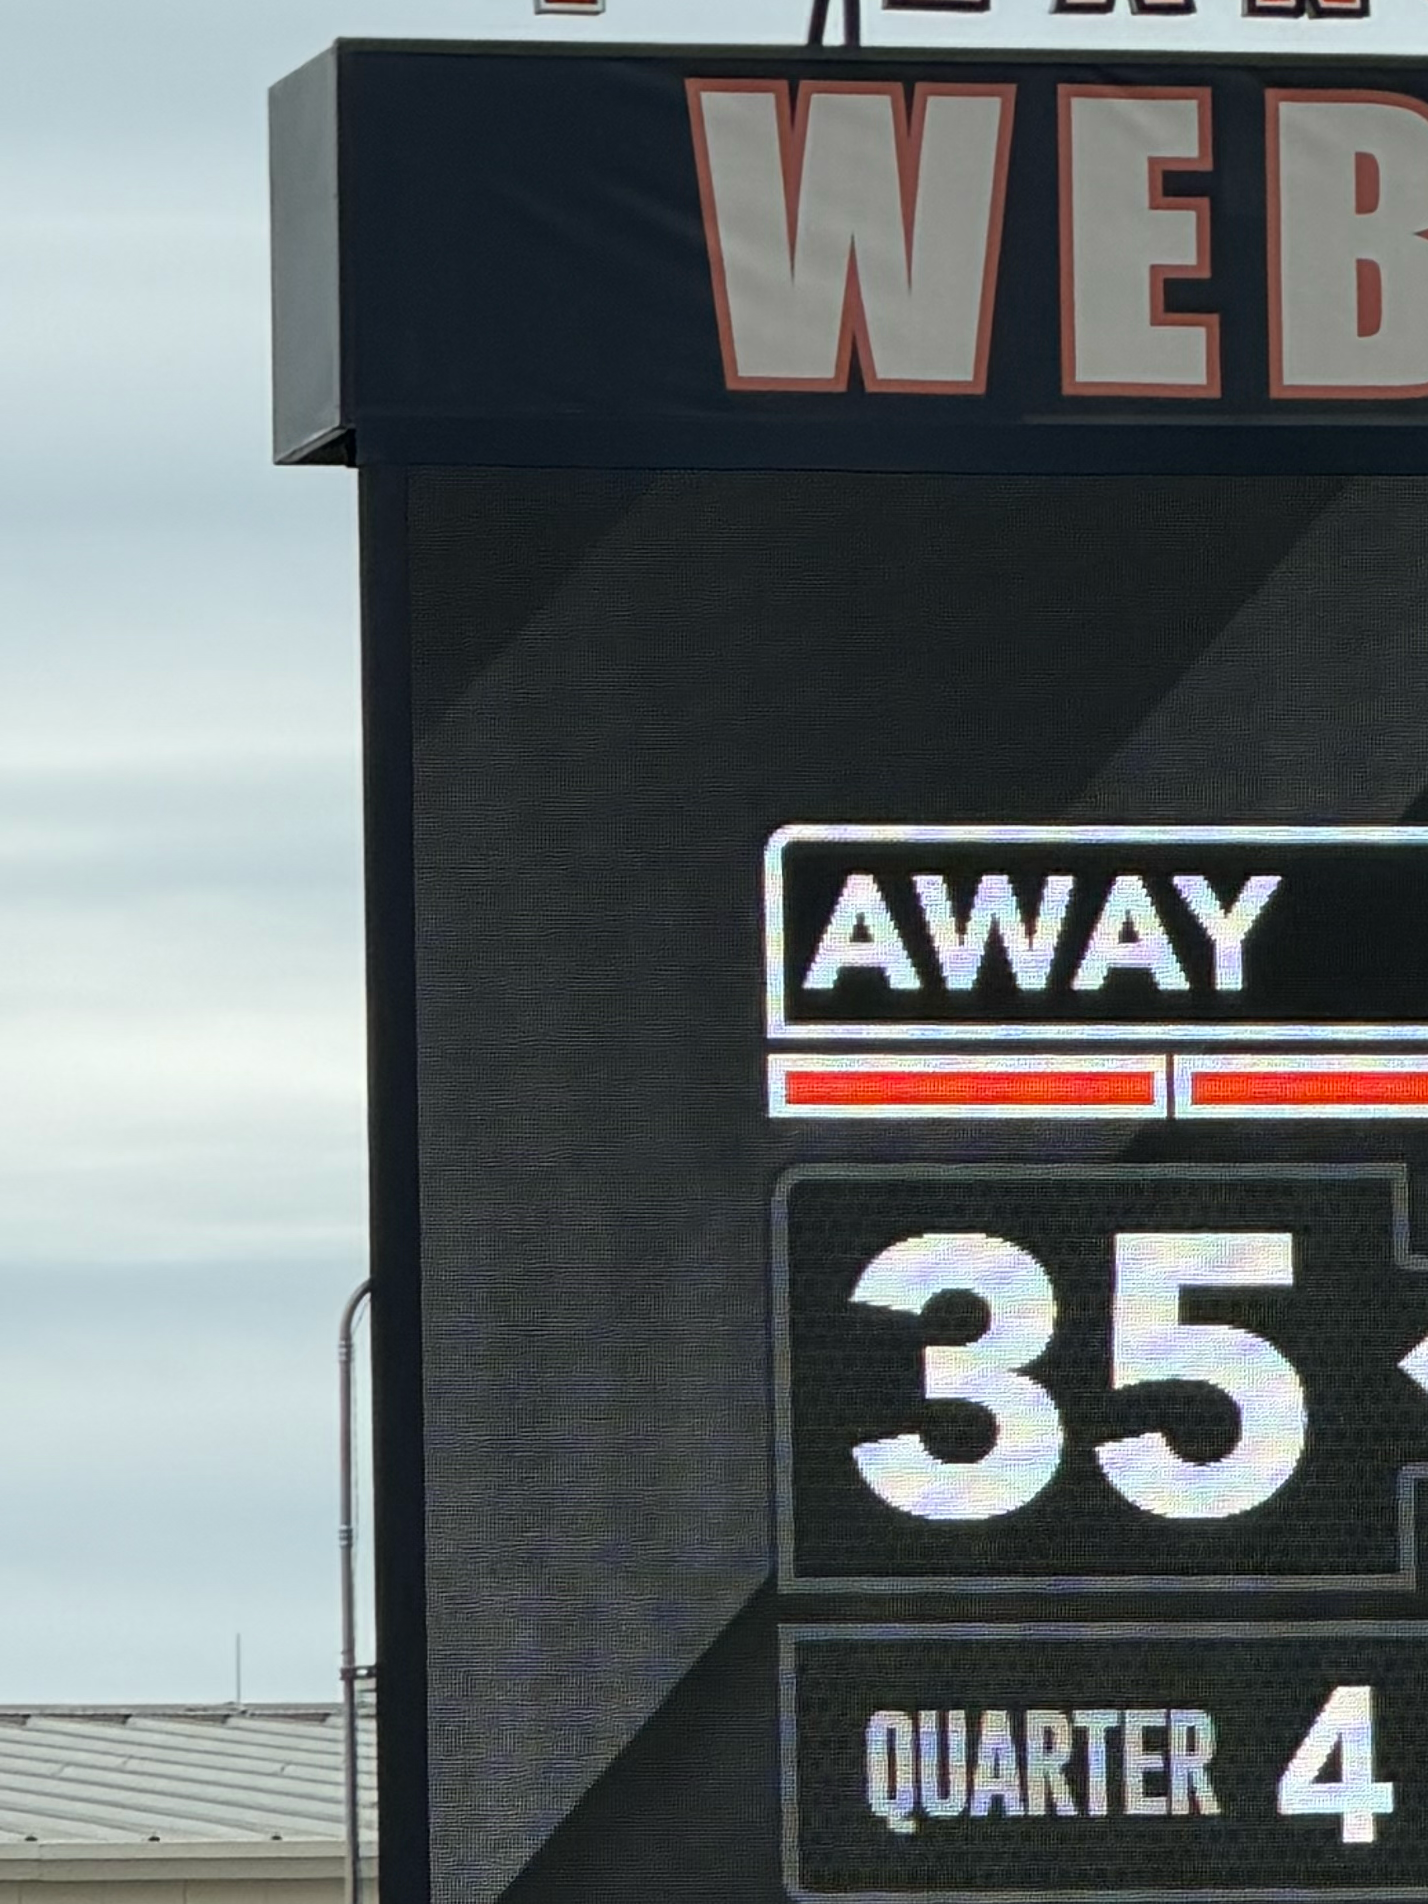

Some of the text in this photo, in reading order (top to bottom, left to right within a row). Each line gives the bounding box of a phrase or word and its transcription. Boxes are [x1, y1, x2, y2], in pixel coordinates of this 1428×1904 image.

[803, 873, 1282, 992] AWAY
[848, 1231, 1308, 1521] 35
[864, 1684, 1395, 1844] QUARTER 4
